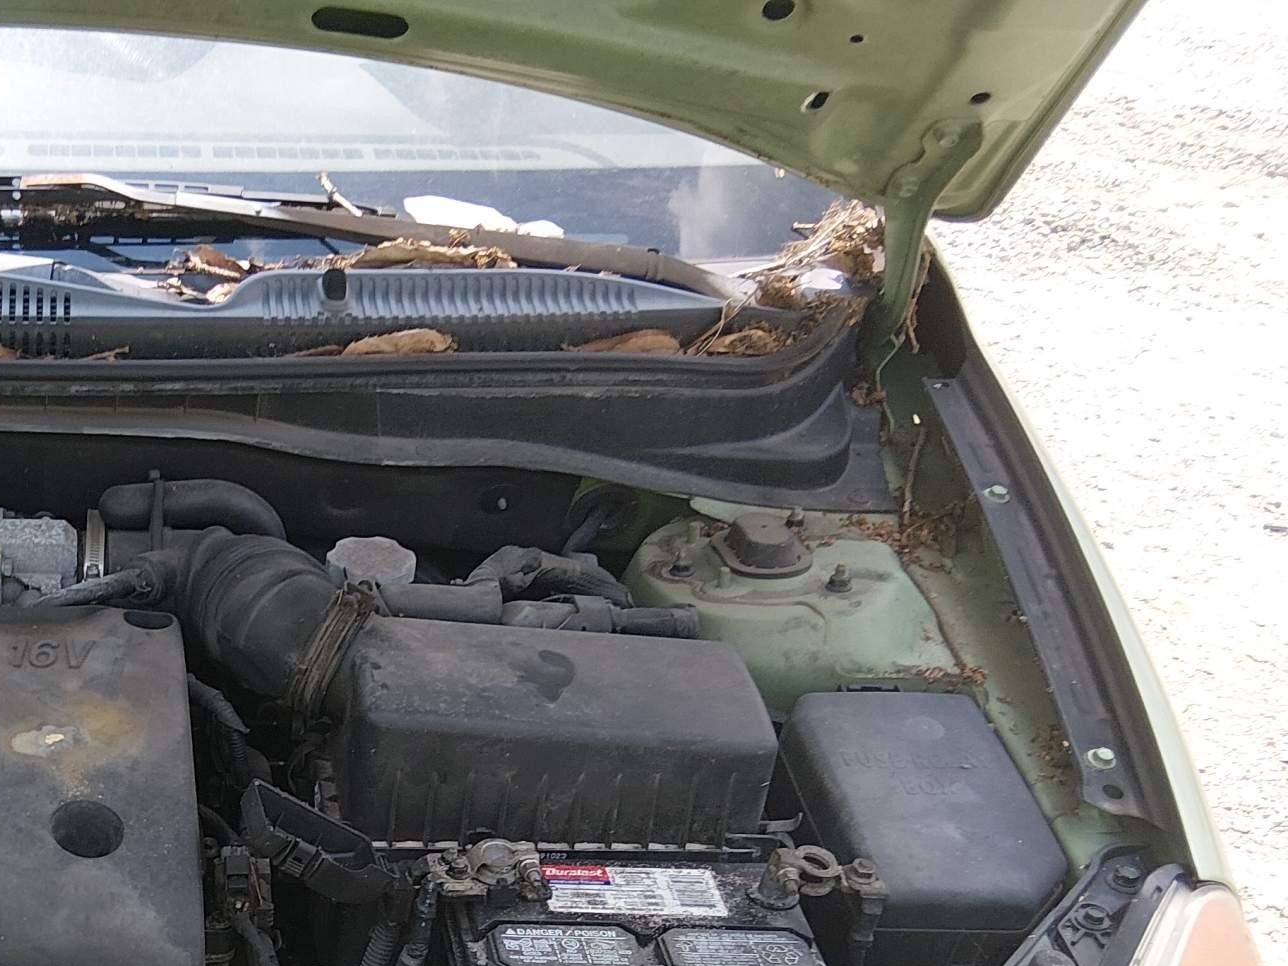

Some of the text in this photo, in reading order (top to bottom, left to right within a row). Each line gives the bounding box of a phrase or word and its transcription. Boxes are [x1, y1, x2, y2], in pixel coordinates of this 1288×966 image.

[5, 638, 97, 669] 16V
[541, 866, 605, 877] Duralast
[516, 928, 563, 936] DANGER
[574, 930, 617, 938] POISON
